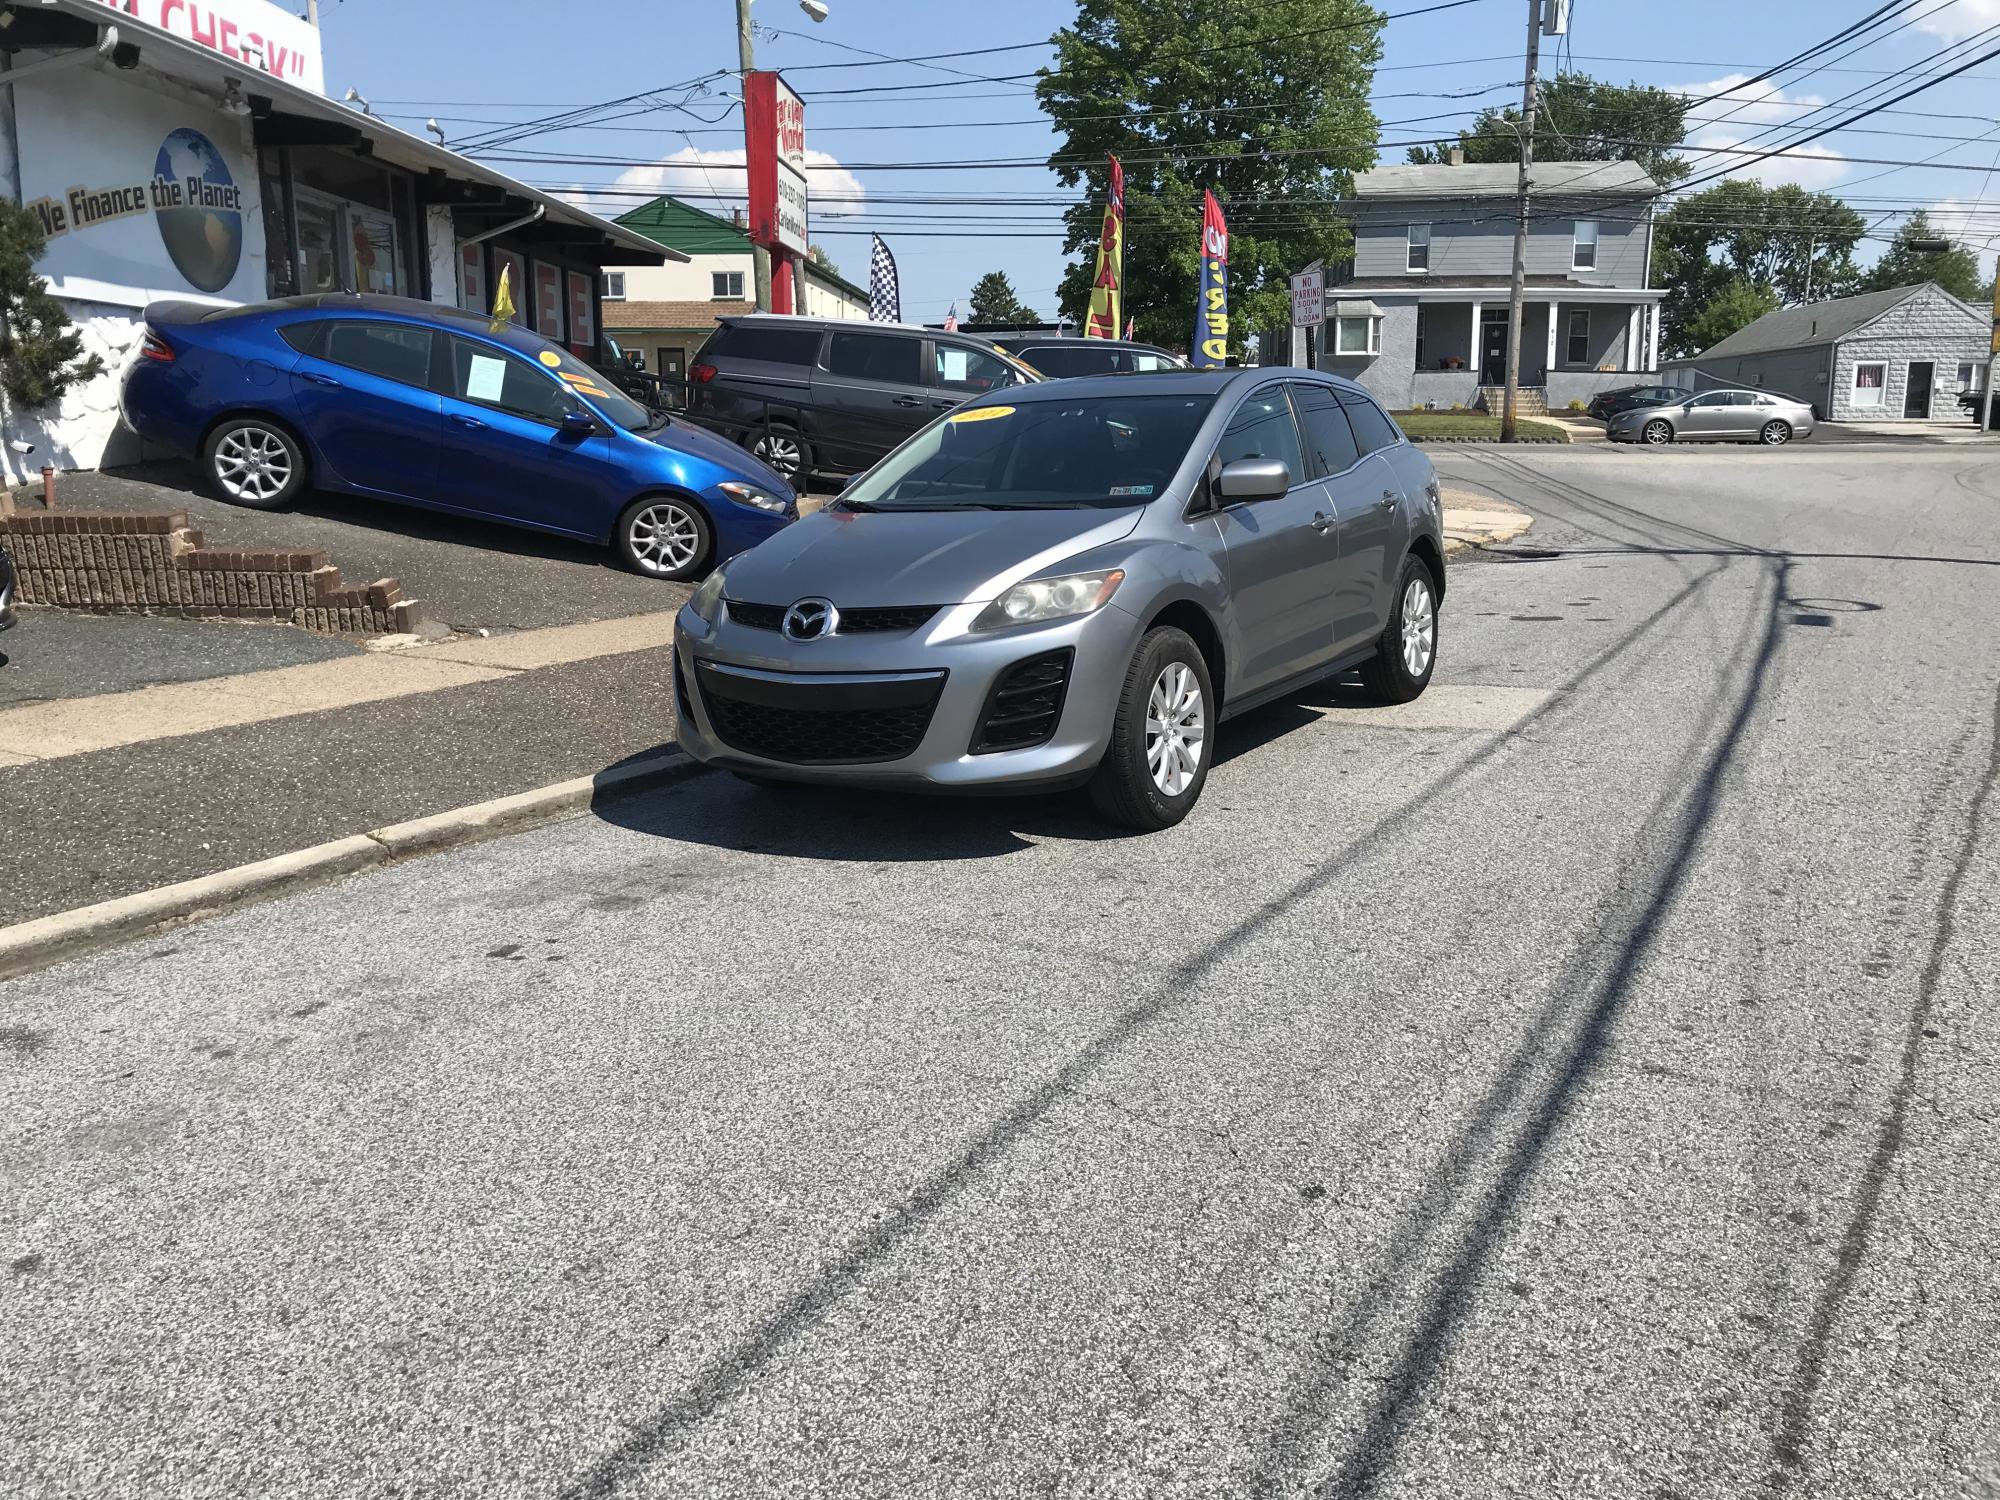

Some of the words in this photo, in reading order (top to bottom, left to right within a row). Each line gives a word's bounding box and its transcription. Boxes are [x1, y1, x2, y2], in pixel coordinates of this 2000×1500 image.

[69, 185, 146, 226] Finance
[150, 177, 182, 208] the
[186, 176, 242, 210] Planet
[1302, 277, 1312, 288] NO
[1295, 286, 1321, 299] PARKING
[1305, 306, 1312, 314] TO
